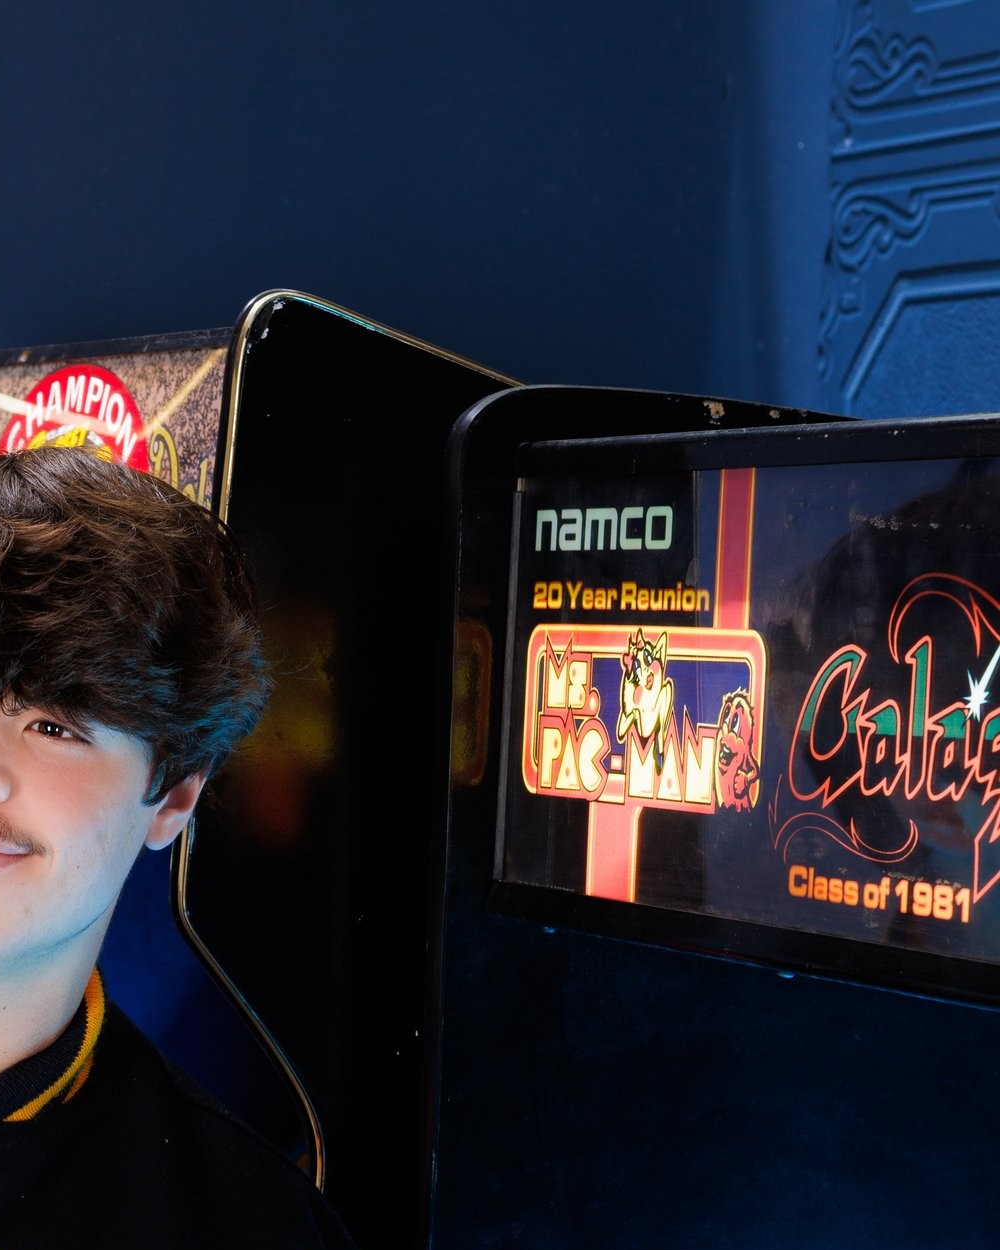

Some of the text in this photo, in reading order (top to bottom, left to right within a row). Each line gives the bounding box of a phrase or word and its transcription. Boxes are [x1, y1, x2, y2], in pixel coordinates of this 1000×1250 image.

[6, 375, 138, 463] CHAMPION
[535, 505, 673, 551] namco
[533, 580, 711, 612] 20 Year Reunion
[539, 715, 715, 809] PAC-MAN
[788, 864, 970, 924] Class of 1981
